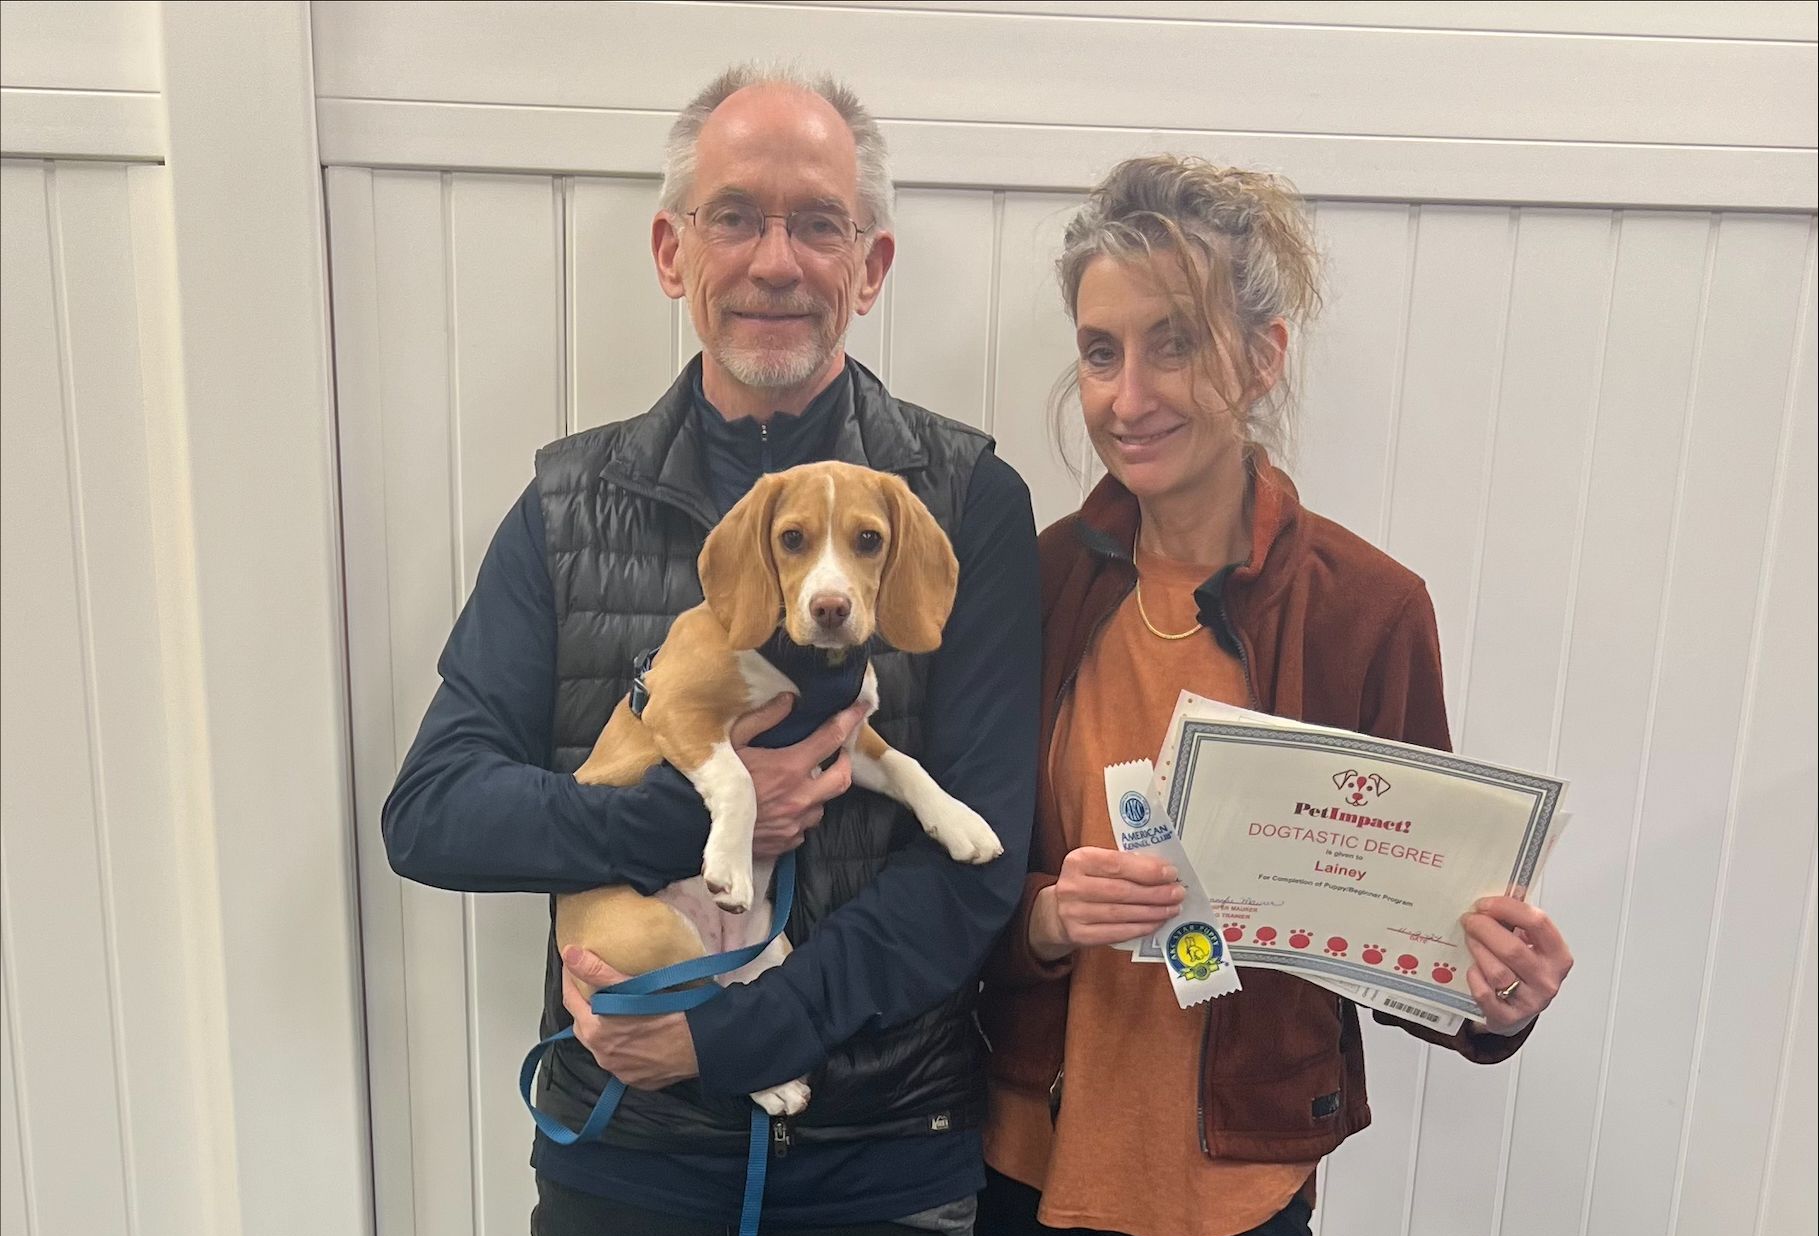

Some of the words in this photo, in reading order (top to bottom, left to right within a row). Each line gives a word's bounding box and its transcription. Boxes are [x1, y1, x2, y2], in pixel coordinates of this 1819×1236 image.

[1293, 802, 1412, 834] PetImpact!
[1121, 824, 1168, 842] AMERICAN
[1248, 822, 1358, 849] DOGTASTIC
[1363, 839, 1445, 869] DEGREE
[1332, 850, 1353, 860] given
[1314, 860, 1367, 882] Lainey
[1257, 873, 1270, 881] For
[1271, 874, 1314, 887] Completion
[1382, 894, 1414, 907] Program
